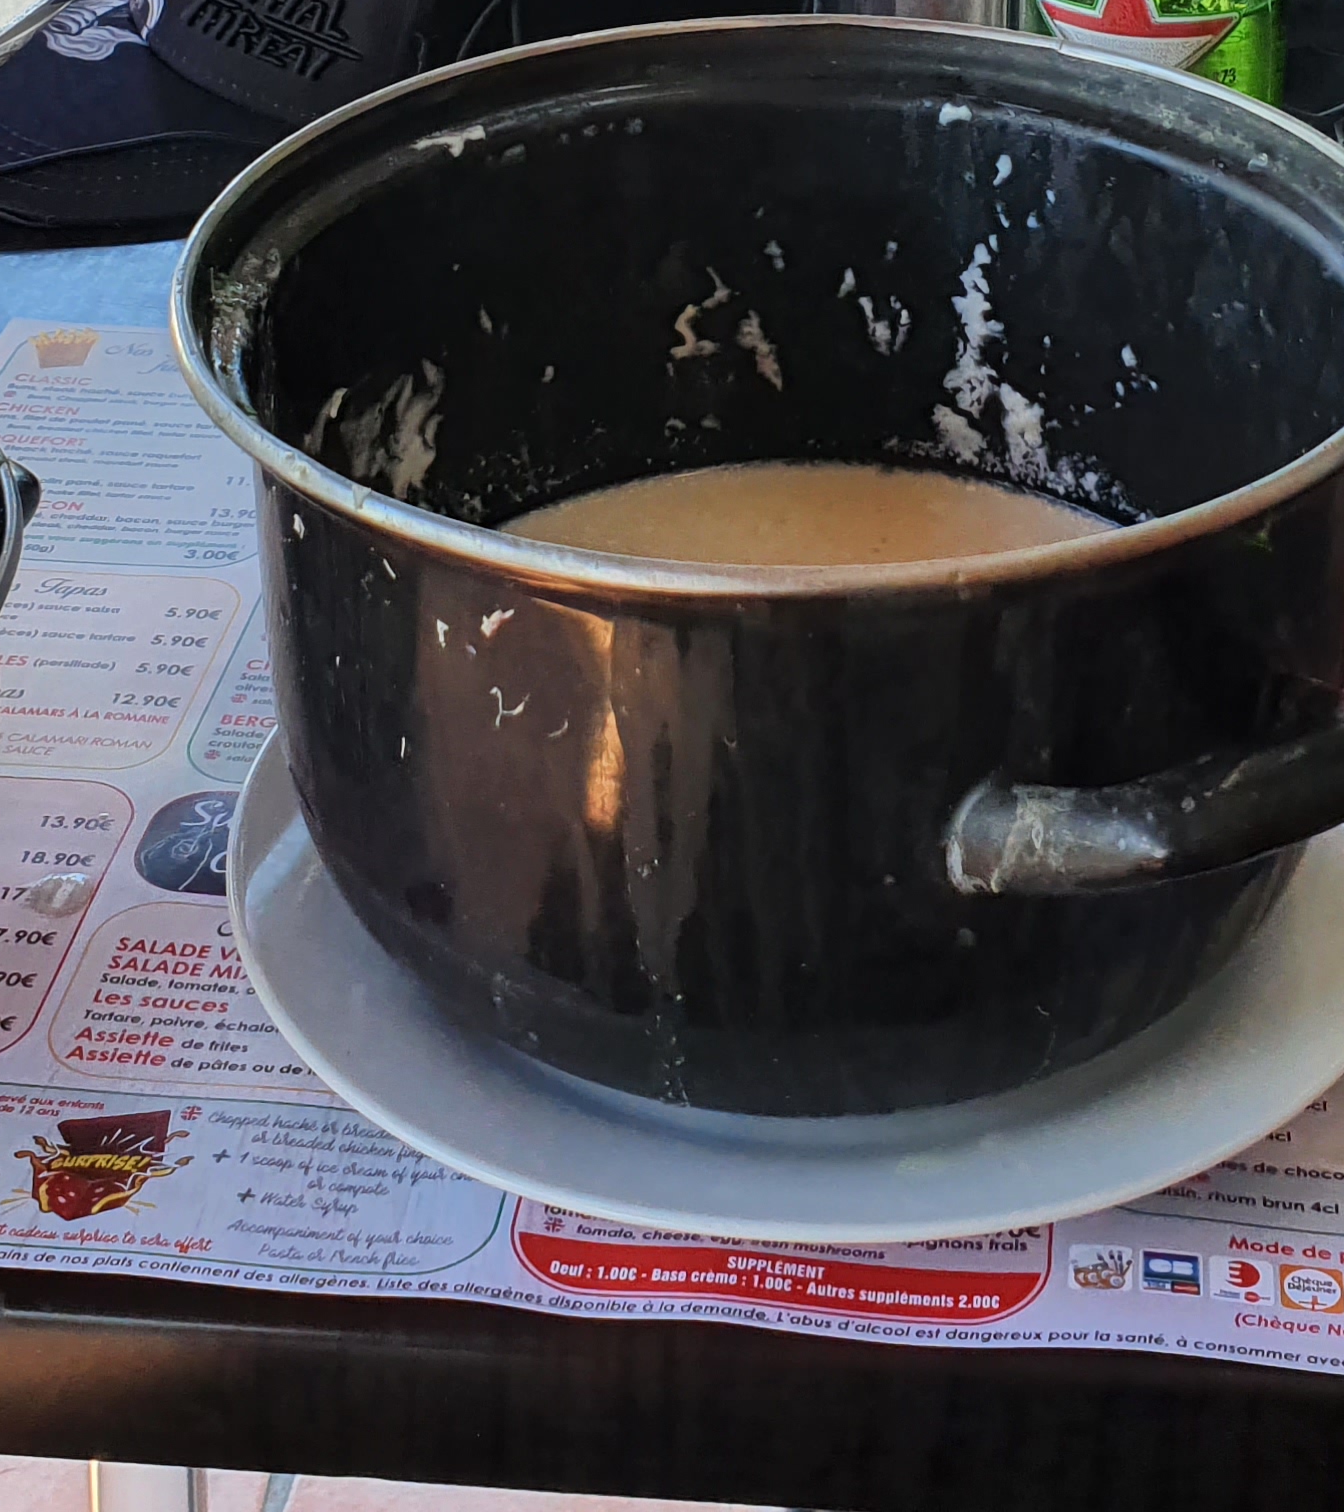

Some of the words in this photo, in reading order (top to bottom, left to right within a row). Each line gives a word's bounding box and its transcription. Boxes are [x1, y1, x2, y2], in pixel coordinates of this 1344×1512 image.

[15, 373, 93, 387] CLASSIC
[183, 548, 240, 561] 3.00€
[35, 577, 108, 599] Tapas
[164, 607, 223, 621] 5.90€
[42, 630, 86, 640] sauce
[151, 634, 209, 648] 5.90€
[135, 661, 194, 677] 5.90€
[112, 691, 182, 708] 12.90€
[104, 711, 170, 724] ROMAINE
[1, 744, 54, 757] SAUCE
[92, 736, 153, 749] ROMAN
[40, 814, 115, 832] 13.90€
[21, 850, 96, 867] 18.90€
[116, 936, 211, 960] SALADE
[108, 955, 204, 979] SALADE
[100, 973, 161, 989] Salade,
[164, 978, 241, 996] tomates,
[93, 988, 133, 1008] Les
[139, 992, 229, 1014] sauces
[83, 1008, 145, 1026] Tartare,
[150, 1014, 208, 1031] poivre,
[74, 1025, 175, 1048] Assiette
[180, 1037, 203, 1050] de
[208, 1038, 249, 1054] frites
[65, 1044, 167, 1068] Assiette
[170, 1056, 194, 1069] de
[197, 1057, 247, 1076] pâtes
[252, 1062, 275, 1075] ou
[51, 1153, 150, 1173] SURPRISE!
[1261, 1196, 1306, 1213] brun
[793, 1241, 886, 1260] mushrooms
[1228, 1235, 1296, 1256] Mode
[1301, 1245, 1332, 1261] de
[727, 1255, 825, 1280] SUPPLÉMENT
[549, 1259, 584, 1277] Oeuf
[651, 1268, 686, 1283] Base
[806, 1281, 856, 1300] Autres
[33, 1251, 57, 1264] de
[64, 1254, 89, 1267] nos
[92, 1254, 133, 1269] plats
[138, 1257, 240, 1279] contiennent
[244, 1268, 274, 1283] des
[376, 1276, 413, 1290] Liste
[417, 1279, 449, 1292] des
[547, 1294, 638, 1314] disponible
[642, 1300, 653, 1313] à
[776, 1311, 832, 1330] L'abus
[837, 1318, 911, 1338] d'alcool
[915, 1328, 941, 1340] est
[945, 1328, 1042, 1344] dangereux
[1047, 1330, 1090, 1343] pour
[1115, 1332, 1170, 1347] santé,
[1175, 1335, 1188, 1348] à
[1193, 1340, 1301, 1363] consommer
[1234, 1311, 1321, 1338] (Chèque
